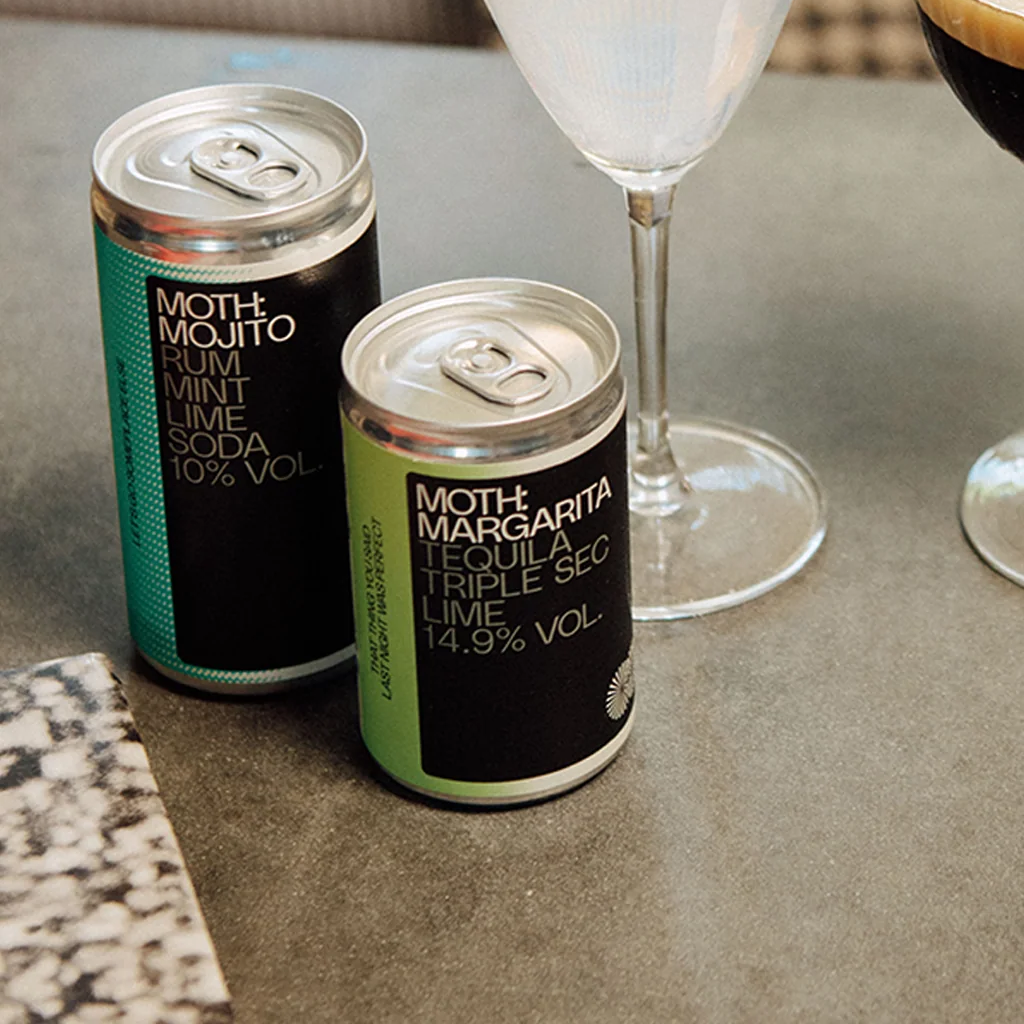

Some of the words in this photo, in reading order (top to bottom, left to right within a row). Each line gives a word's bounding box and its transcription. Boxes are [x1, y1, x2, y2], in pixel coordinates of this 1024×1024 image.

[156, 287, 266, 320] MOTH:
[159, 315, 296, 349] MOJITO
[160, 345, 241, 376] RUM
[164, 372, 250, 404] MINT
[166, 400, 247, 431] LIME
[168, 427, 270, 459] SODA
[170, 456, 235, 487] 10%
[244, 452, 323, 485] VOL.
[416, 483, 529, 516] MOTH:
[417, 476, 613, 544] MARGARITA
[419, 530, 573, 573] TEQUILA
[420, 565, 543, 599] TRIPLE
[554, 534, 610, 584] SEC
[422, 595, 507, 626] LIME
[422, 624, 526, 654] 14.9%
[535, 603, 603, 646] VOL.
